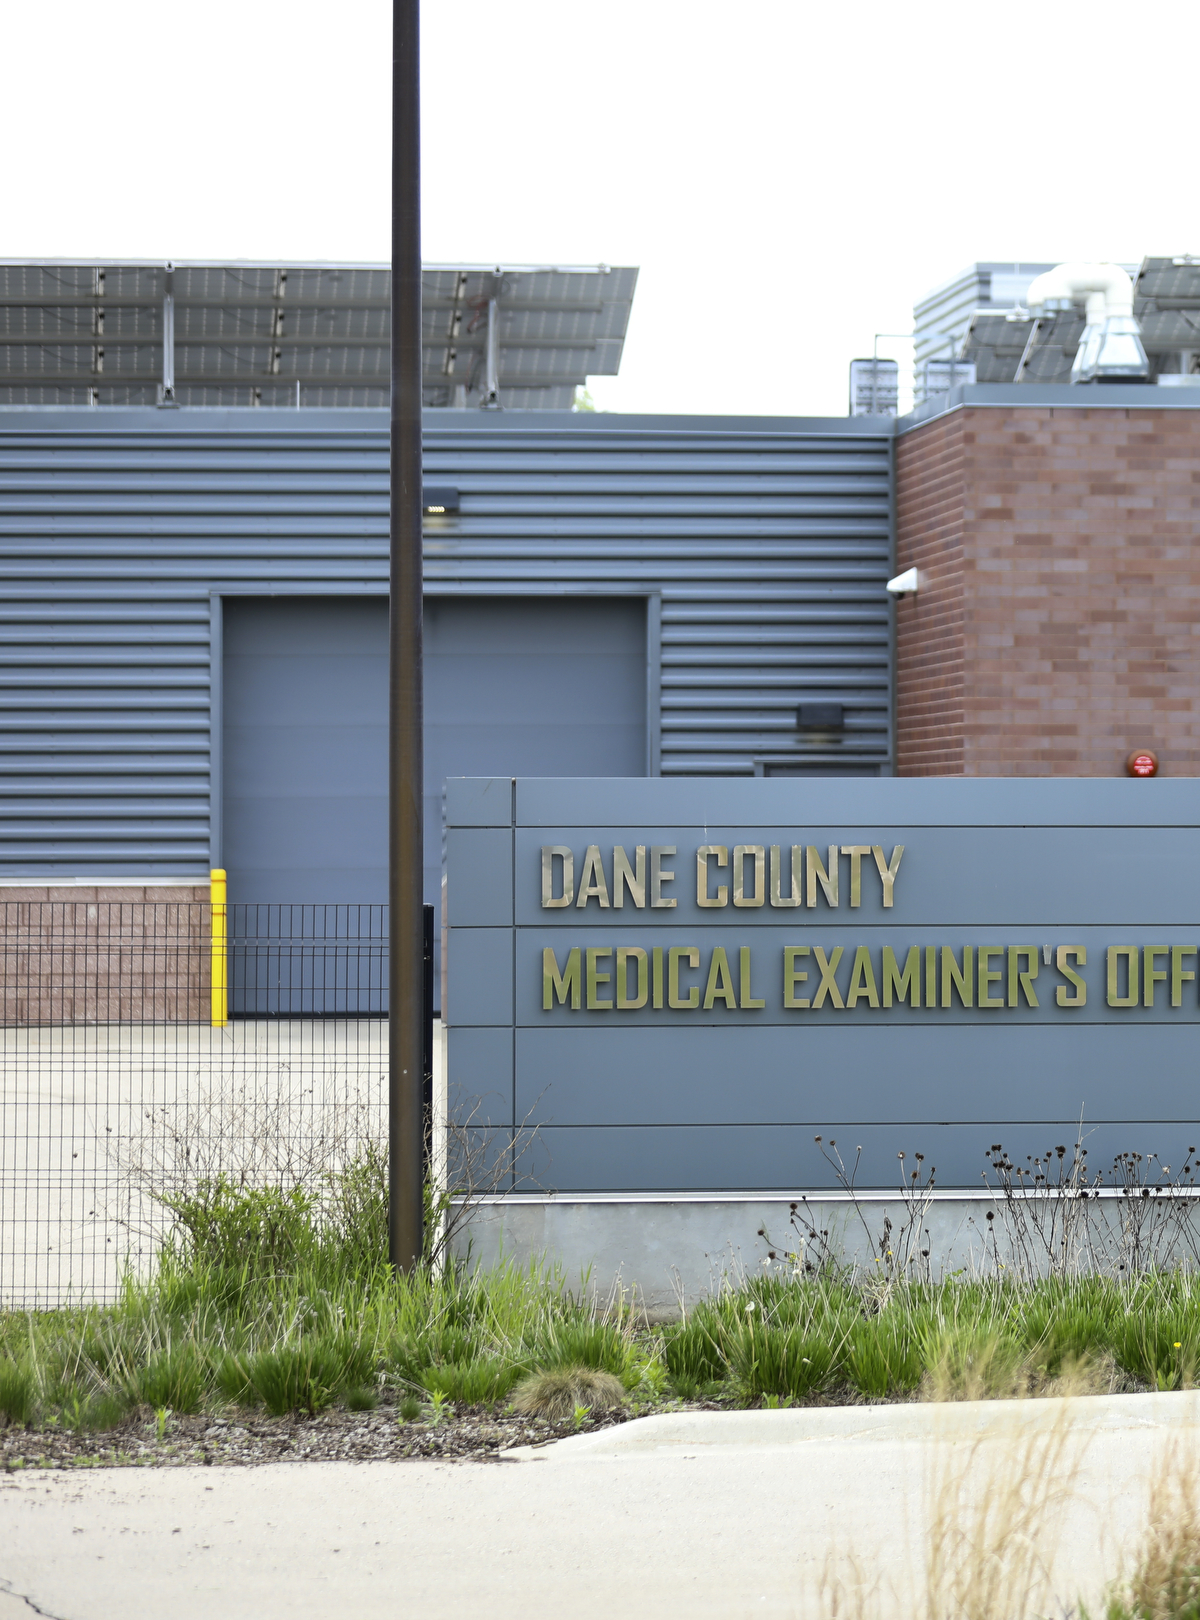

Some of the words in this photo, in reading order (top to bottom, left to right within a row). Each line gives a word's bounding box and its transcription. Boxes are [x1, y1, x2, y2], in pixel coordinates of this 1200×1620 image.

[541, 845, 677, 908] DANE
[696, 845, 905, 908] COUNTY
[542, 946, 766, 1010] MEDICAL
[783, 945, 1087, 1008] EXAMINER'S
